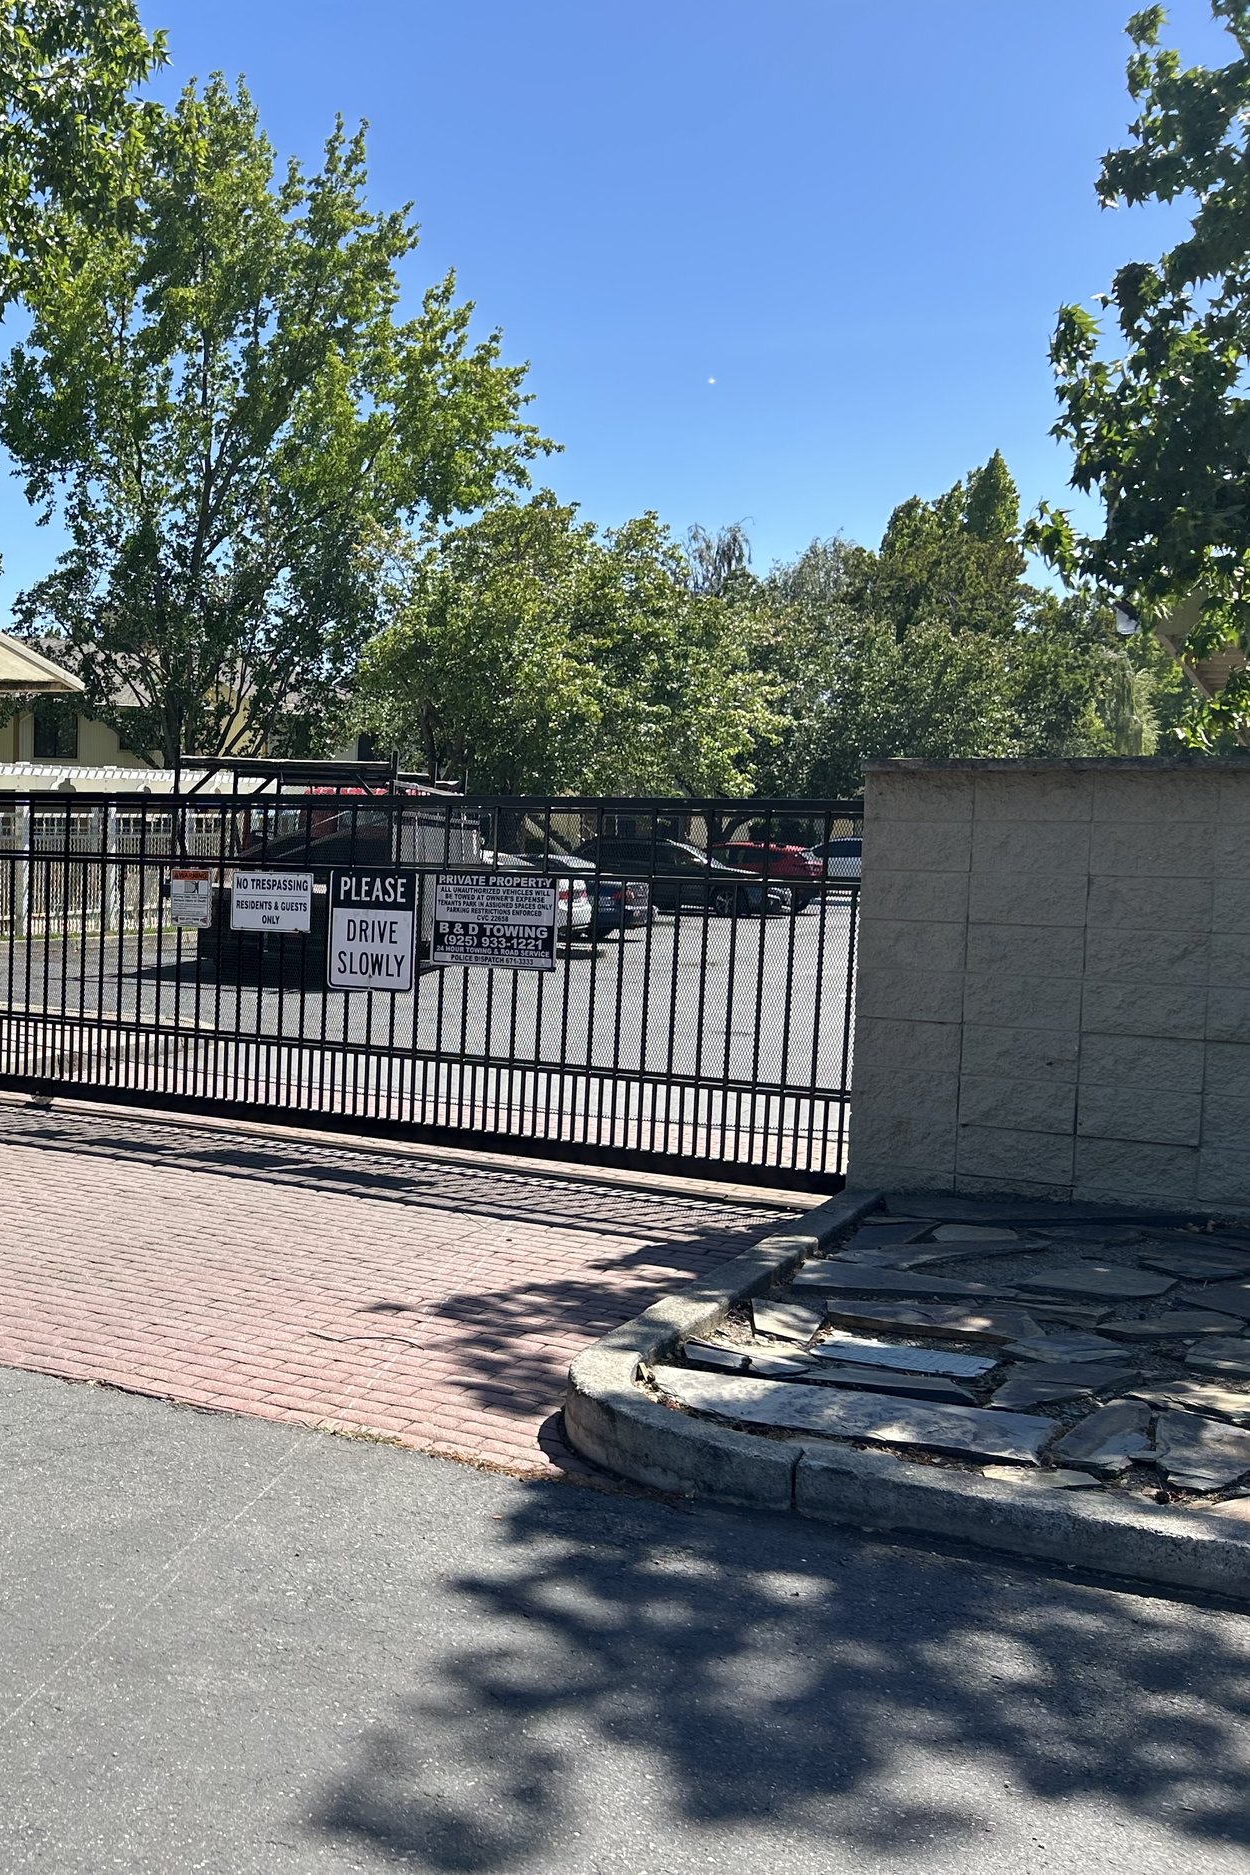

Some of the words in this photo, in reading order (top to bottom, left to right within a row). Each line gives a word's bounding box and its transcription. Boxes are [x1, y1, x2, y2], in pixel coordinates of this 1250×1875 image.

[236, 877, 248, 889] NO
[250, 878, 308, 891] TRESPASSING
[439, 875, 486, 886] PRIVATE
[489, 876, 552, 888] PROPERTY
[340, 876, 406, 902] PLEASE
[453, 887, 500, 895] UNAUTHORIZED
[236, 900, 273, 910] RESIDENTS
[274, 901, 278, 911] &
[281, 902, 307, 911] GUESTS
[471, 908, 510, 916] RESTRICTIONS
[262, 915, 280, 925] ONLY
[347, 919, 398, 944] DRIVE
[439, 922, 449, 933] B
[453, 923, 464, 934] &
[468, 924, 479, 935] D
[483, 924, 548, 938] TOWING
[444, 934, 478, 947] (925)
[481, 936, 543, 950] 933-1221
[451, 954, 472, 962] POLICE
[474, 956, 504, 964] DISPATCH
[466, 947, 492, 955] TOWING
[520, 950, 550, 958] SERVICE
[338, 950, 405, 978] SLOWLY
